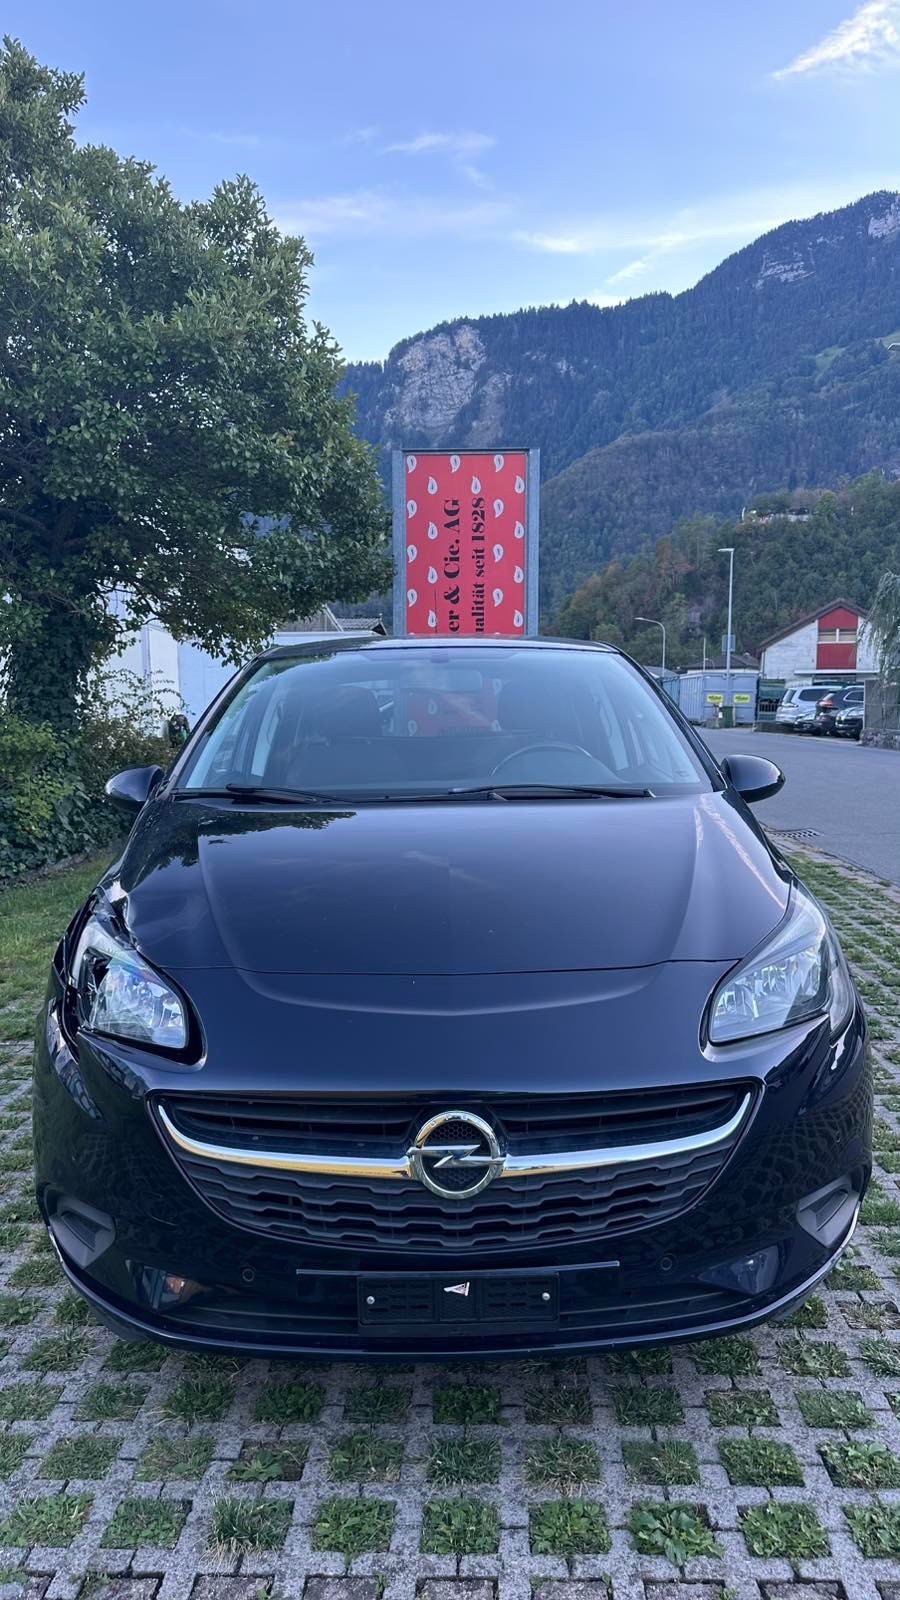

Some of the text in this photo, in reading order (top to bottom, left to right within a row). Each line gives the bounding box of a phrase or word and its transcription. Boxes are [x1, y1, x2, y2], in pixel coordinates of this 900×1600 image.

[443, 499, 460, 533] AG
[471, 497, 485, 541] 1828
[443, 539, 460, 579] Cie.
[471, 548, 485, 577] seit
[443, 585, 460, 604] &
